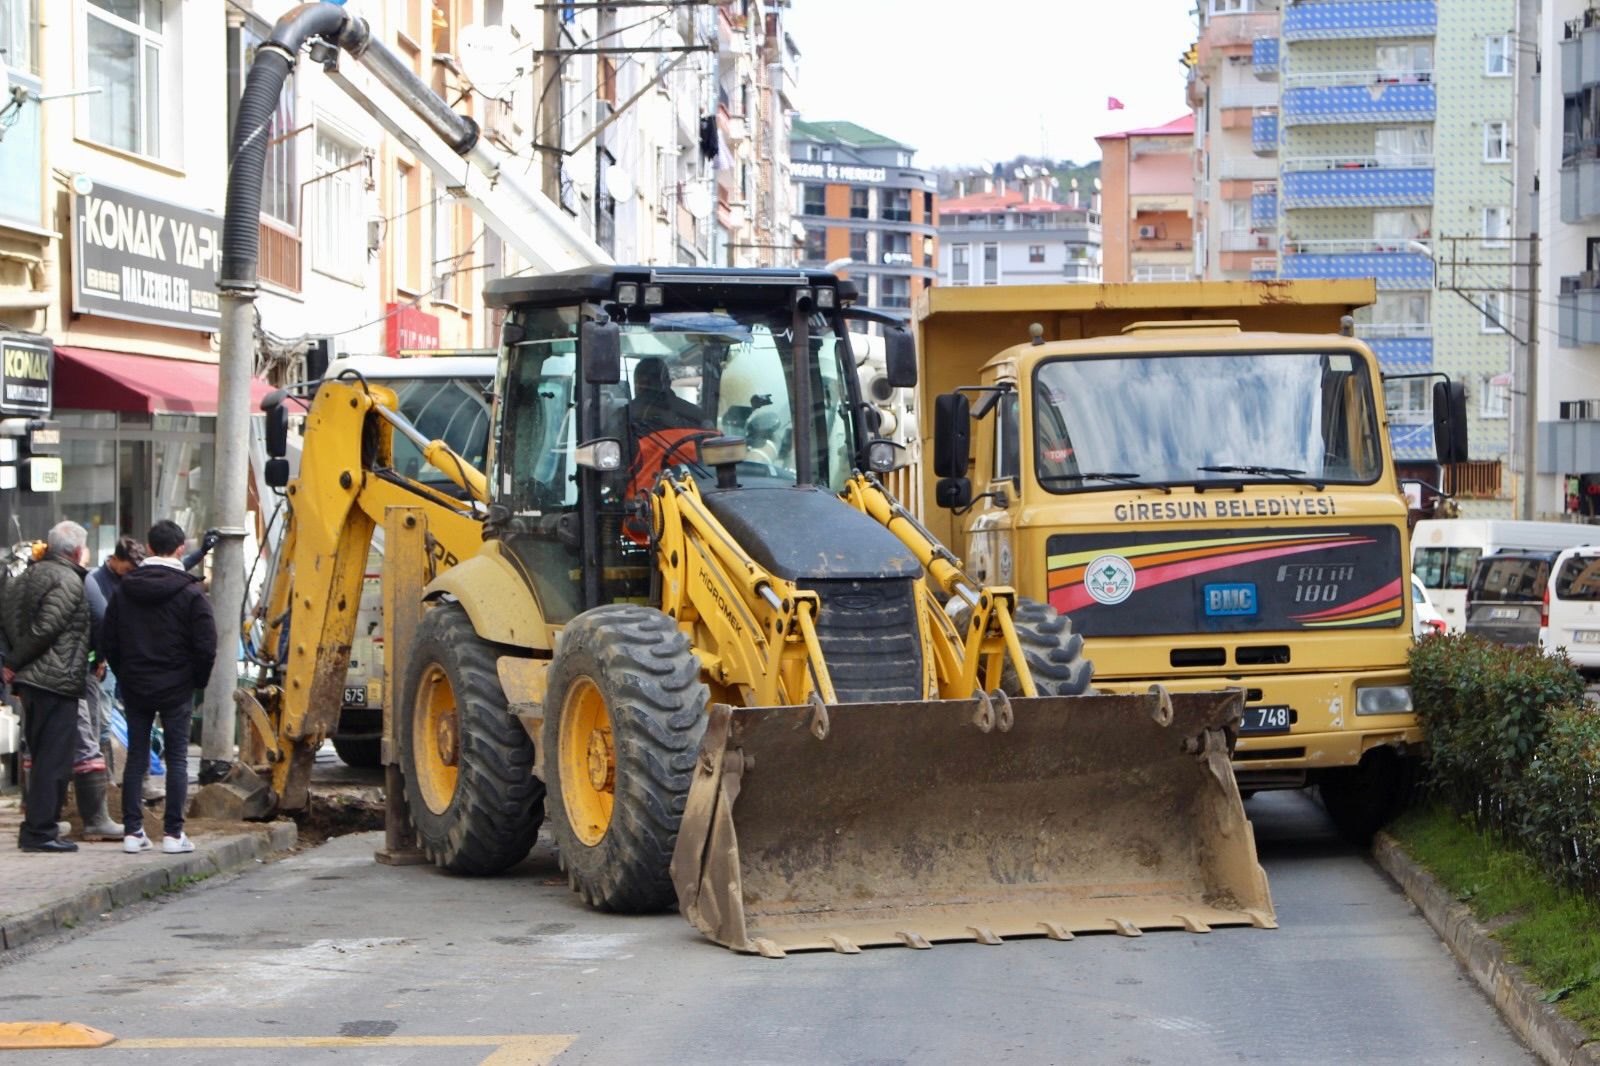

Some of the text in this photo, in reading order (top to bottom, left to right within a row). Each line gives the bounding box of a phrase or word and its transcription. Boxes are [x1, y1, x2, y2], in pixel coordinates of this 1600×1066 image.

[85, 194, 166, 261] KONAK
[4, 349, 48, 381] KONAK
[1114, 495, 1337, 522] GİRESUN BELEDİYESİ
[1210, 588, 1253, 610] BMC
[344, 688, 364, 702] 675
[1258, 708, 1286, 727] 748
